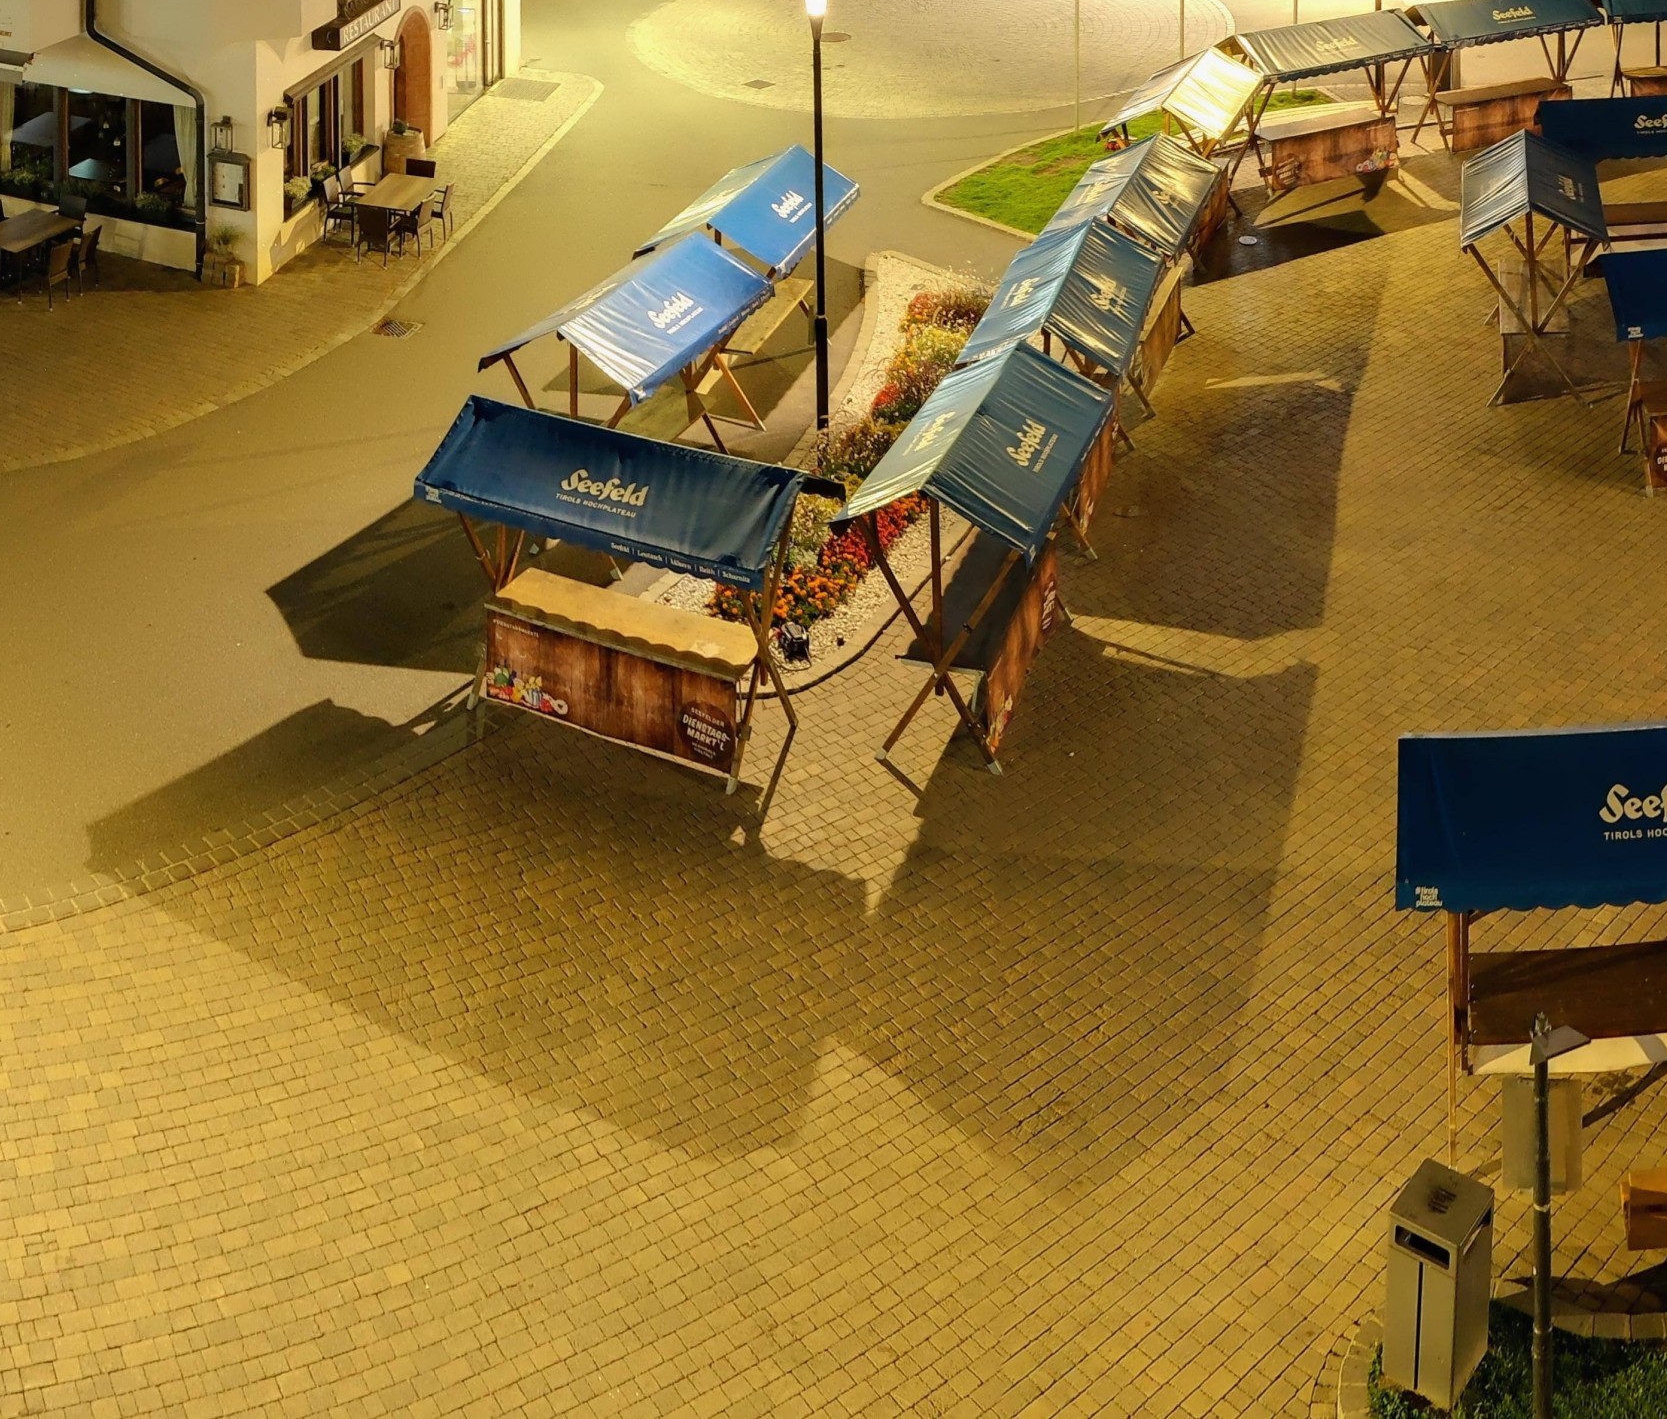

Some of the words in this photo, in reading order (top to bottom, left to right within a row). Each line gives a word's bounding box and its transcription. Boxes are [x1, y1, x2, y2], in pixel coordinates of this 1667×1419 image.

[1492, 5, 1533, 21] Seefeld
[648, 292, 694, 329] Seefeld
[1006, 417, 1046, 467] Seefeld
[560, 468, 650, 507] Seefeld
[555, 492, 582, 505] TIROLS
[583, 499, 637, 518] HOCHPLATEAU
[1603, 828, 1643, 841] TIROLS
